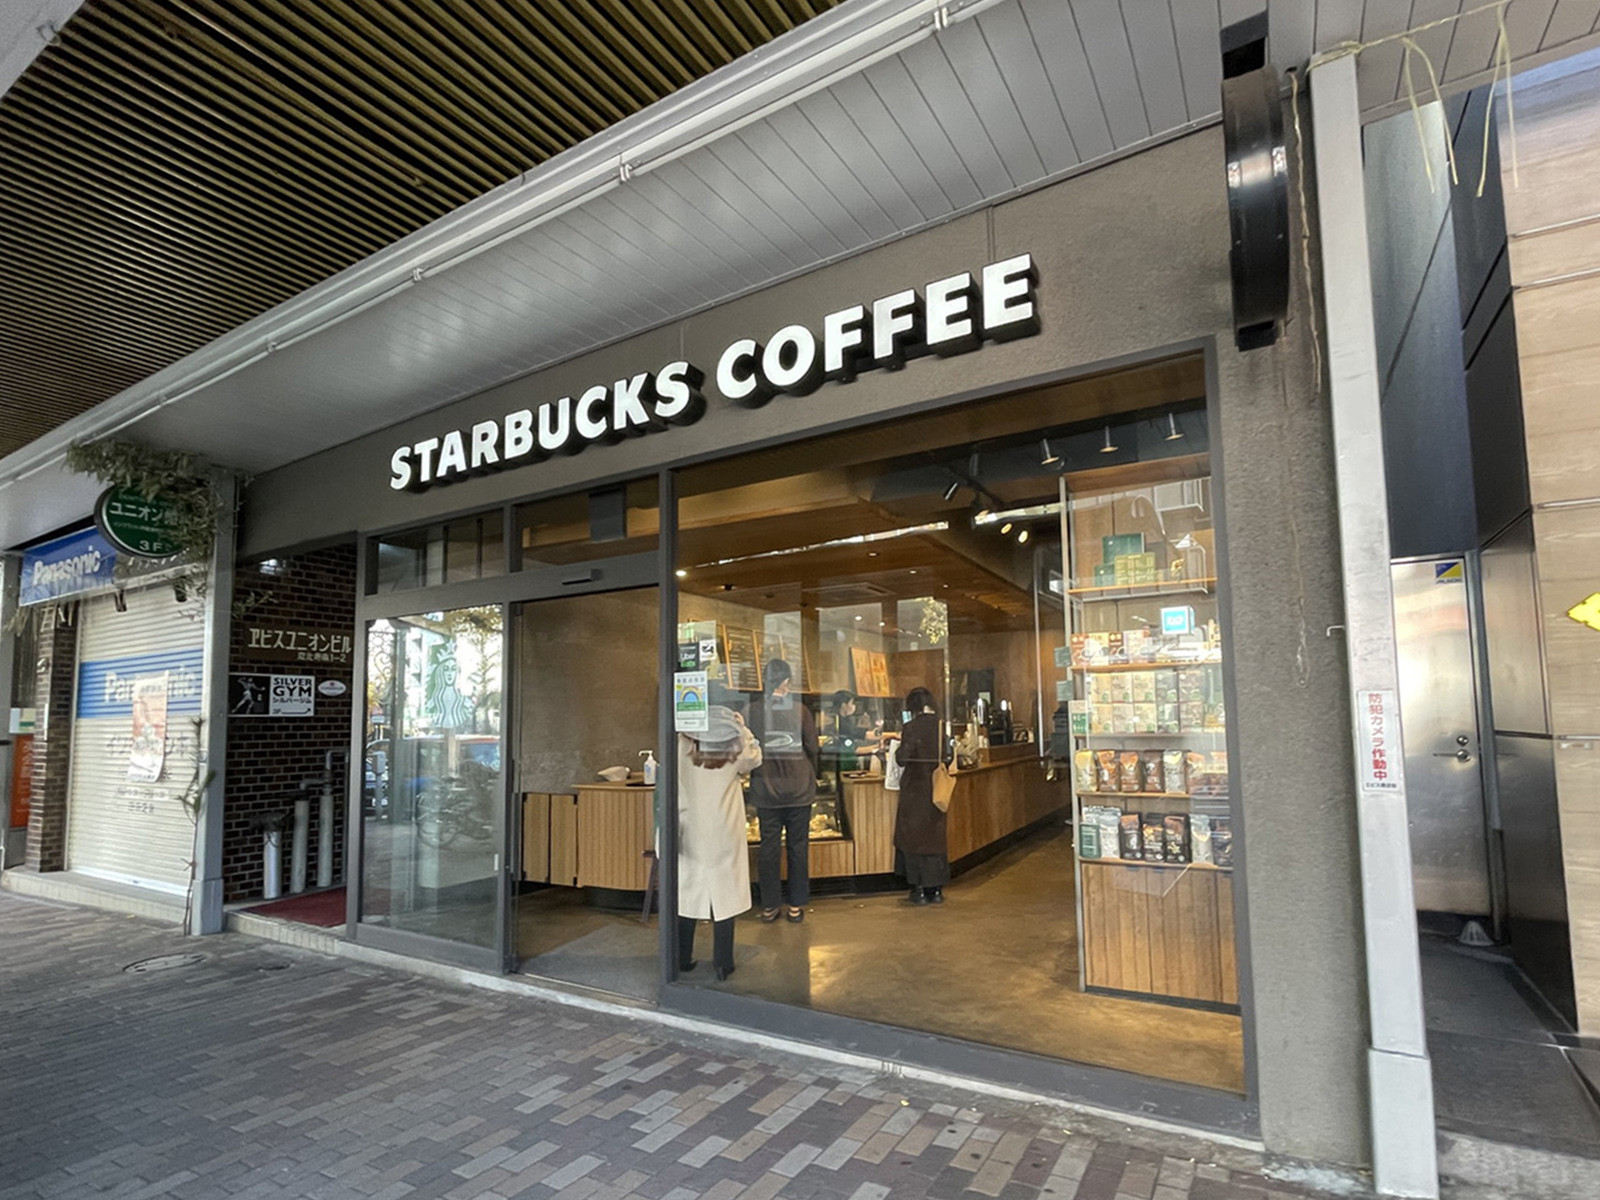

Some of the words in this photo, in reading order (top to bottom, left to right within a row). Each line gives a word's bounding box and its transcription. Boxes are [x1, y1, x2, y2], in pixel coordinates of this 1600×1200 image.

[390, 360, 692, 490] STARBUCKS
[716, 254, 1034, 399] COFFEE
[32, 545, 101, 586] Panasonic
[272, 677, 313, 686] SILVER
[272, 686, 313, 697] GYM
[1368, 693, 1387, 781] 防犯カメラ作動中
